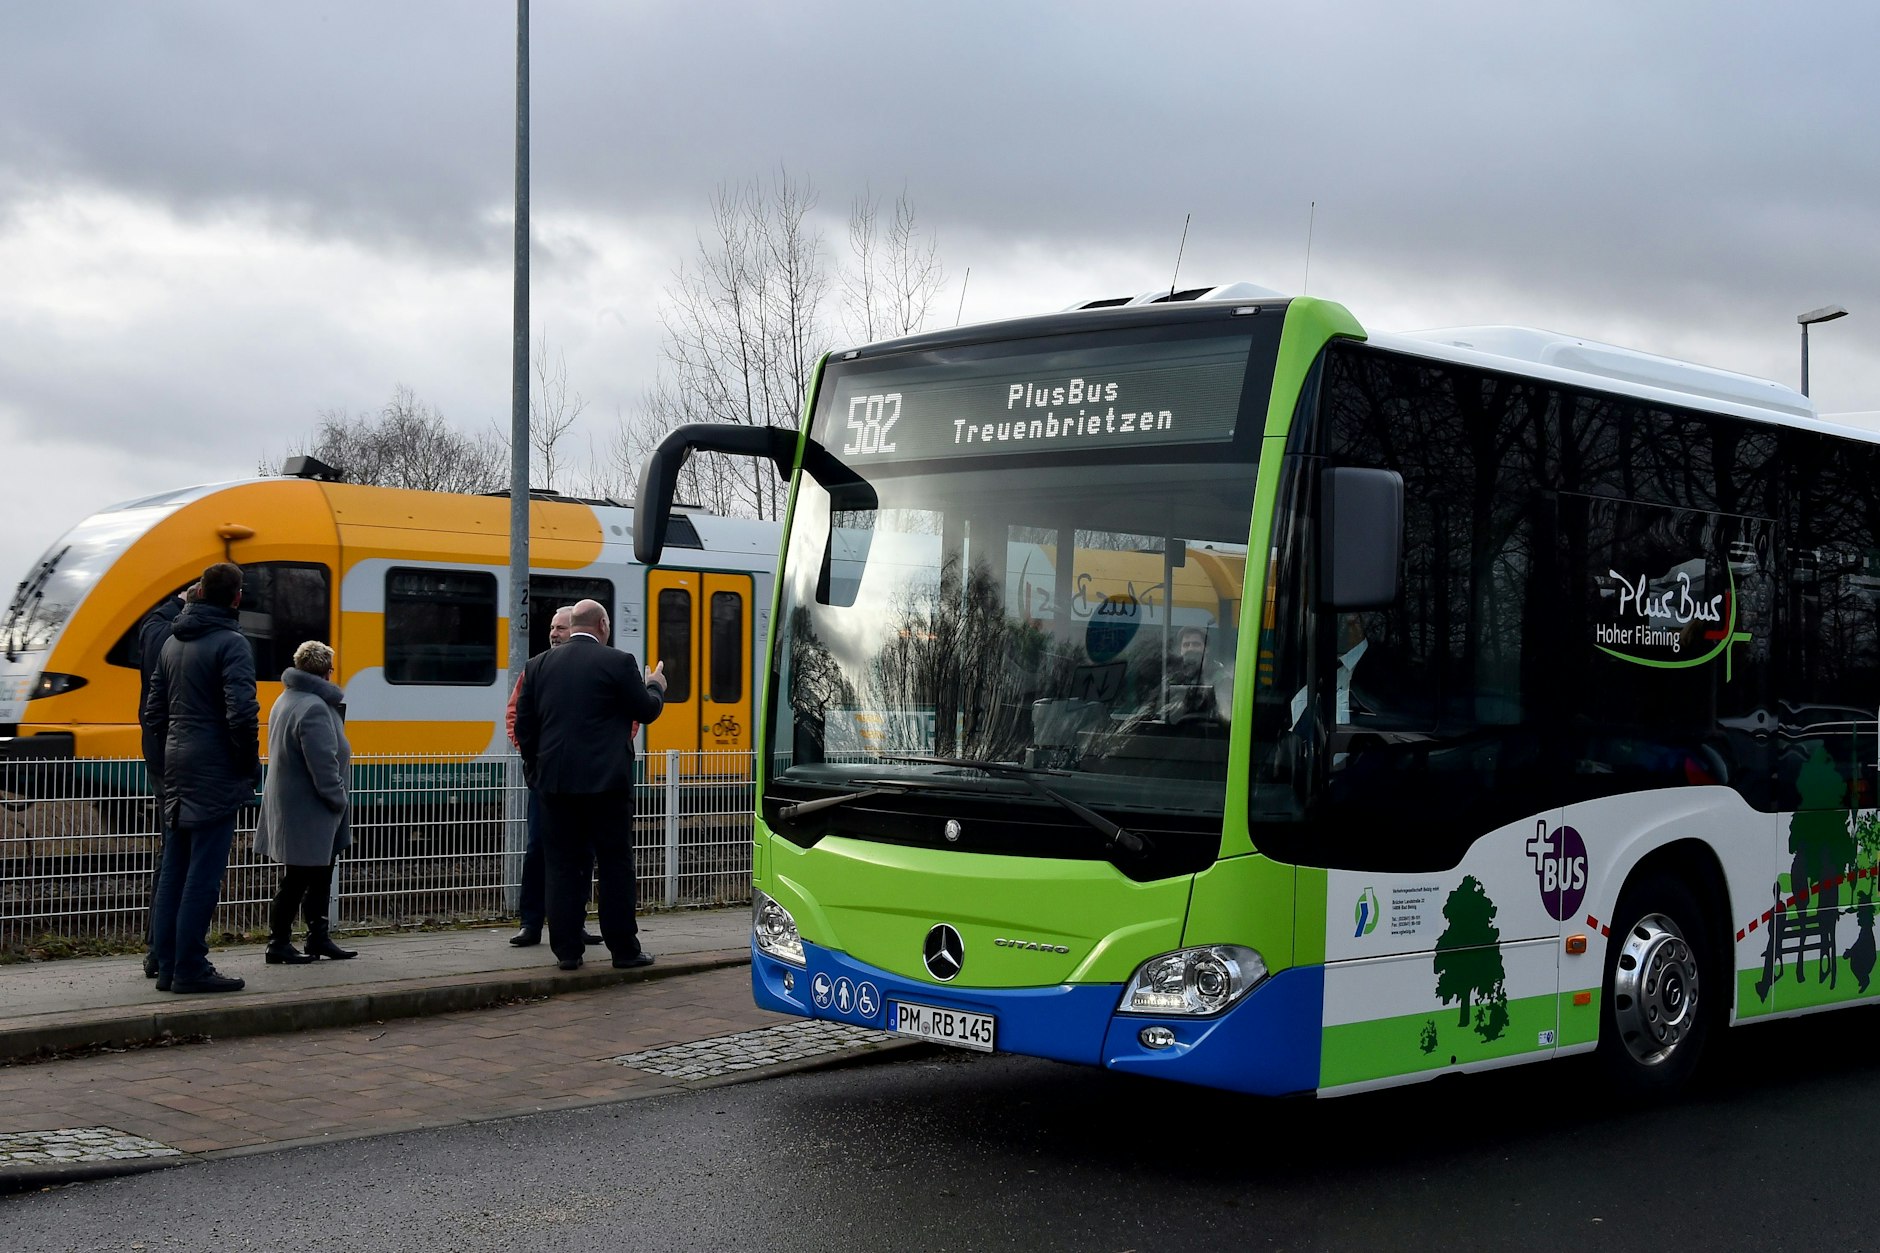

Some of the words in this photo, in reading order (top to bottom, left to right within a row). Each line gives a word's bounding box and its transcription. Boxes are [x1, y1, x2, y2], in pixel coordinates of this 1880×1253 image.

[1007, 378, 1118, 410] PlusBus
[843, 392, 903, 456] 582
[953, 407, 1173, 444] Treuenbrietzen
[1596, 622, 1633, 645] Hoher
[1635, 624, 1681, 653] Fläming
[993, 937, 1070, 955] CITARO
[899, 1006, 921, 1032] PM
[932, 1011, 955, 1037] RB
[958, 1016, 993, 1044] 145
